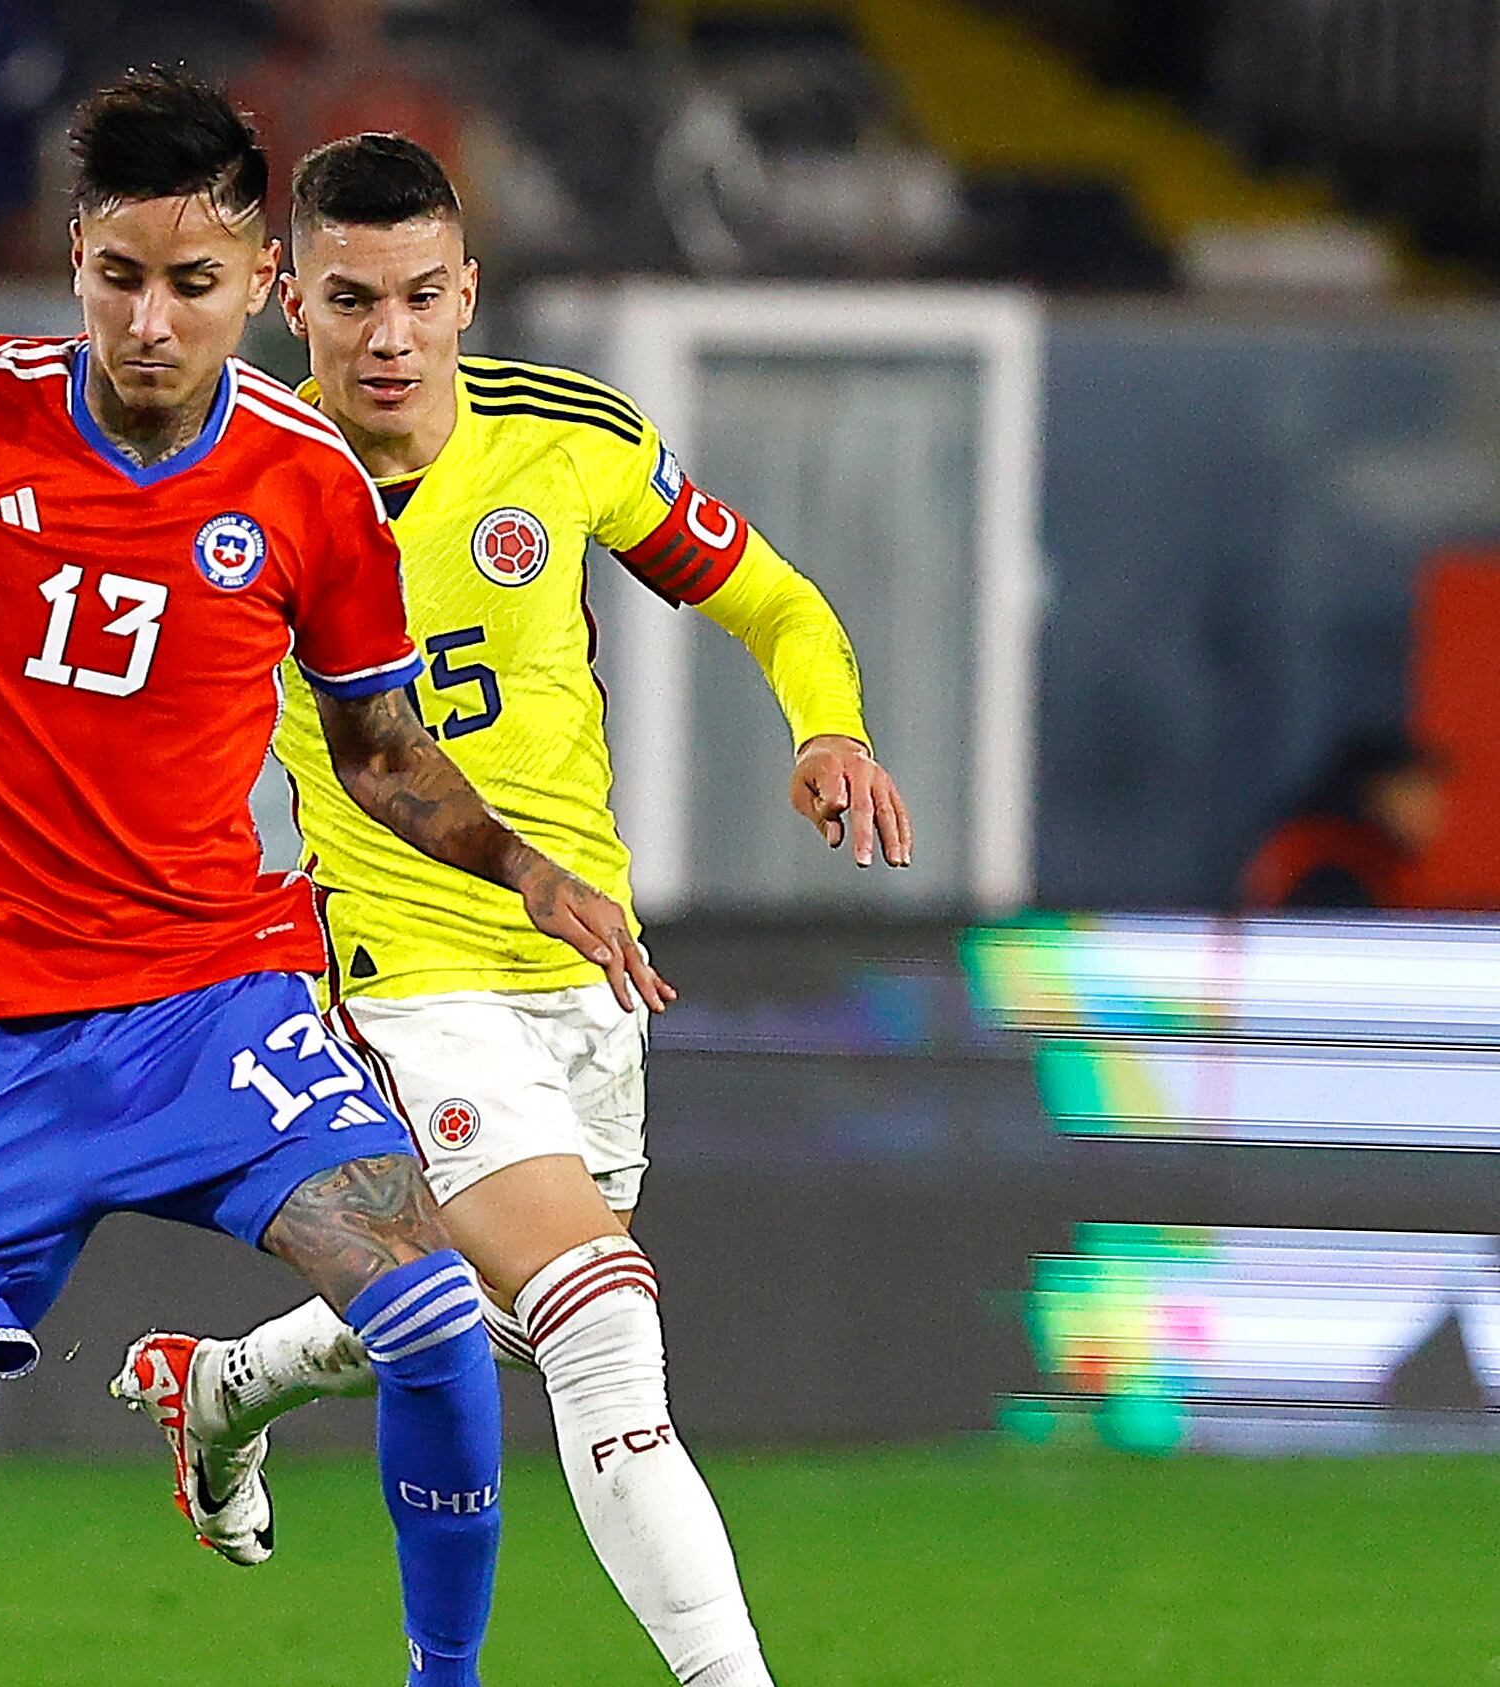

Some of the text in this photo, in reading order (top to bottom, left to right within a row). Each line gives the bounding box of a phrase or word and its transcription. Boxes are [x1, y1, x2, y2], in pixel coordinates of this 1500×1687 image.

[686, 490, 737, 550] C
[24, 563, 169, 697] 13
[230, 1012, 365, 1133] 13
